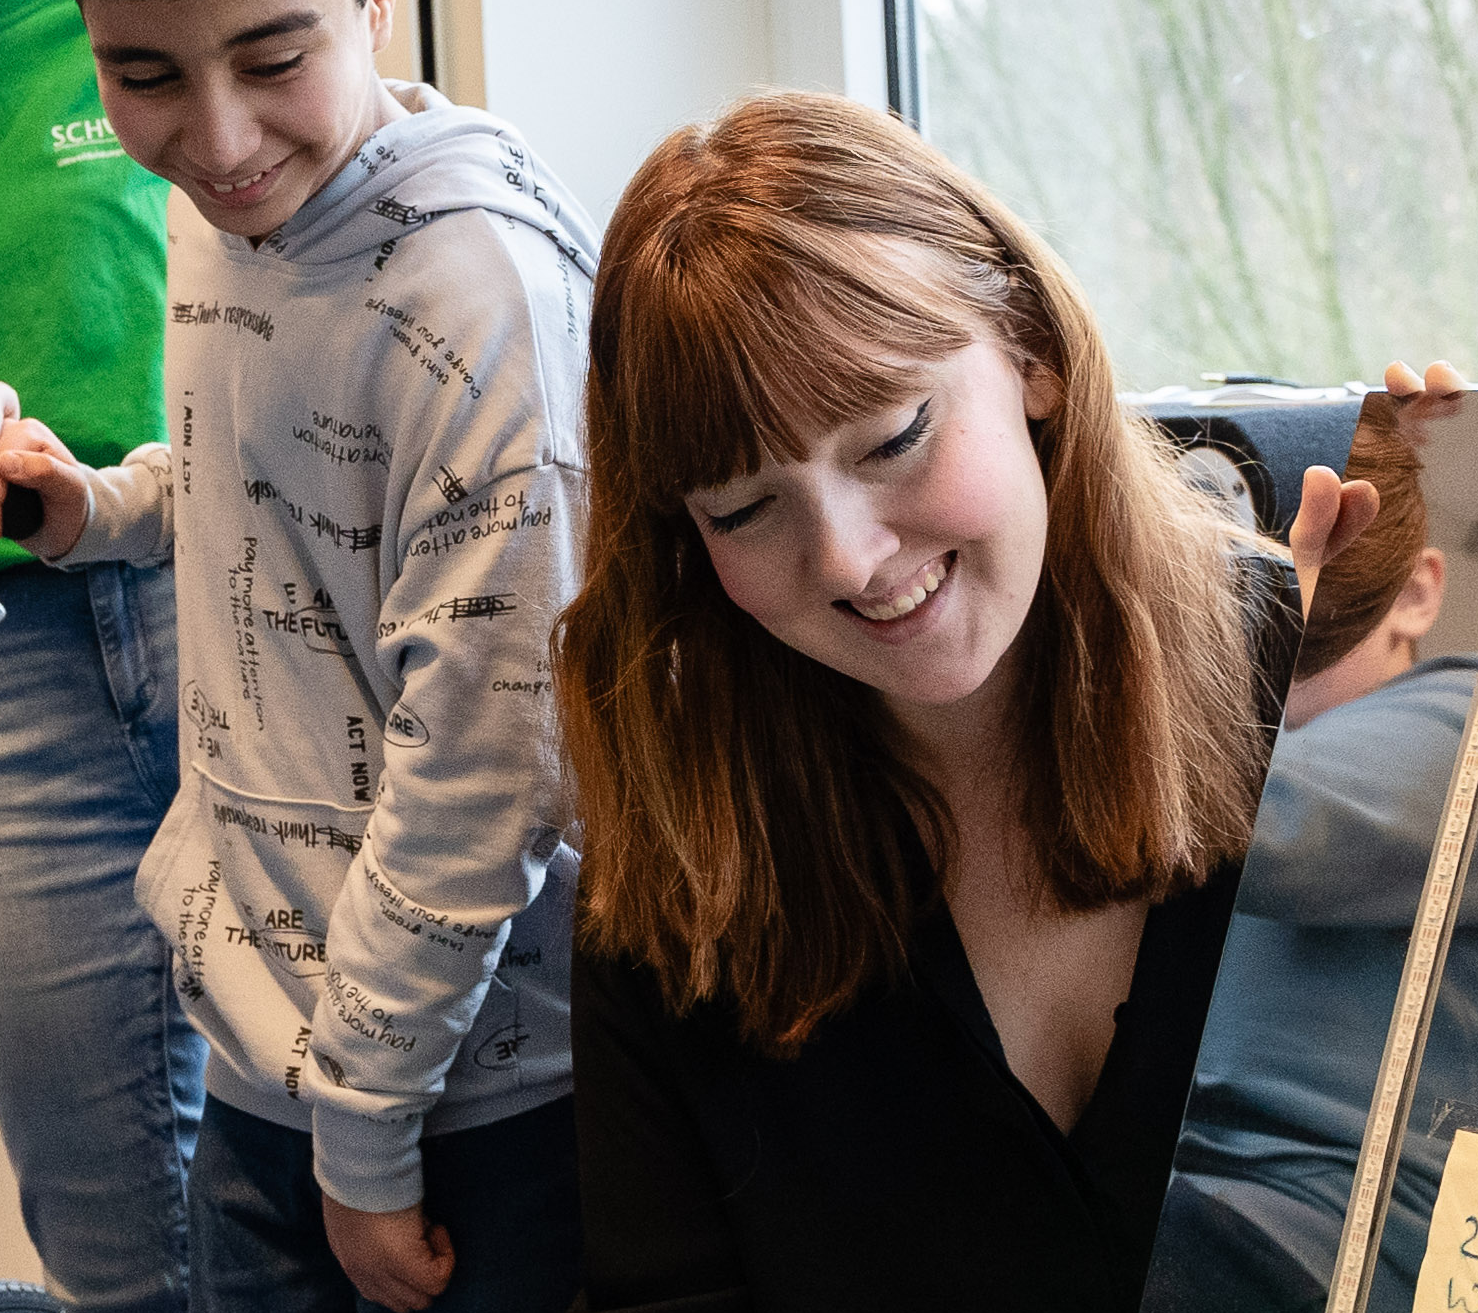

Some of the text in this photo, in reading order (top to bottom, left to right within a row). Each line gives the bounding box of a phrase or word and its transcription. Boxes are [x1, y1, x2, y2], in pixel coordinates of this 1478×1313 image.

[416, 326, 445, 351] your
[420, 358, 450, 386] think
[183, 405, 194, 447] NOW
[182, 457, 192, 495] ACT
[469, 498, 501, 520] the
[503, 490, 527, 508] to
[470, 517, 518, 540] more
[521, 505, 552, 529] pay
[238, 536, 258, 574] pay
[408, 527, 467, 557] atten
[228, 564, 241, 590] to
[229, 595, 241, 626] the
[242, 576, 255, 630] more
[262, 609, 299, 634] THE
[346, 715, 372, 803] ACT NOW
[271, 822, 320, 848] think
[200, 859, 221, 895] pay
[182, 885, 201, 908] to
[178, 911, 195, 942] the
[195, 895, 216, 942] more
[264, 908, 304, 930] ARE
[409, 905, 449, 928] your
[224, 925, 262, 949] THE
[346, 986, 368, 1015] the
[337, 1004, 417, 1053] pay more
[371, 1007, 394, 1025] to
[293, 1025, 313, 1060] ACT
